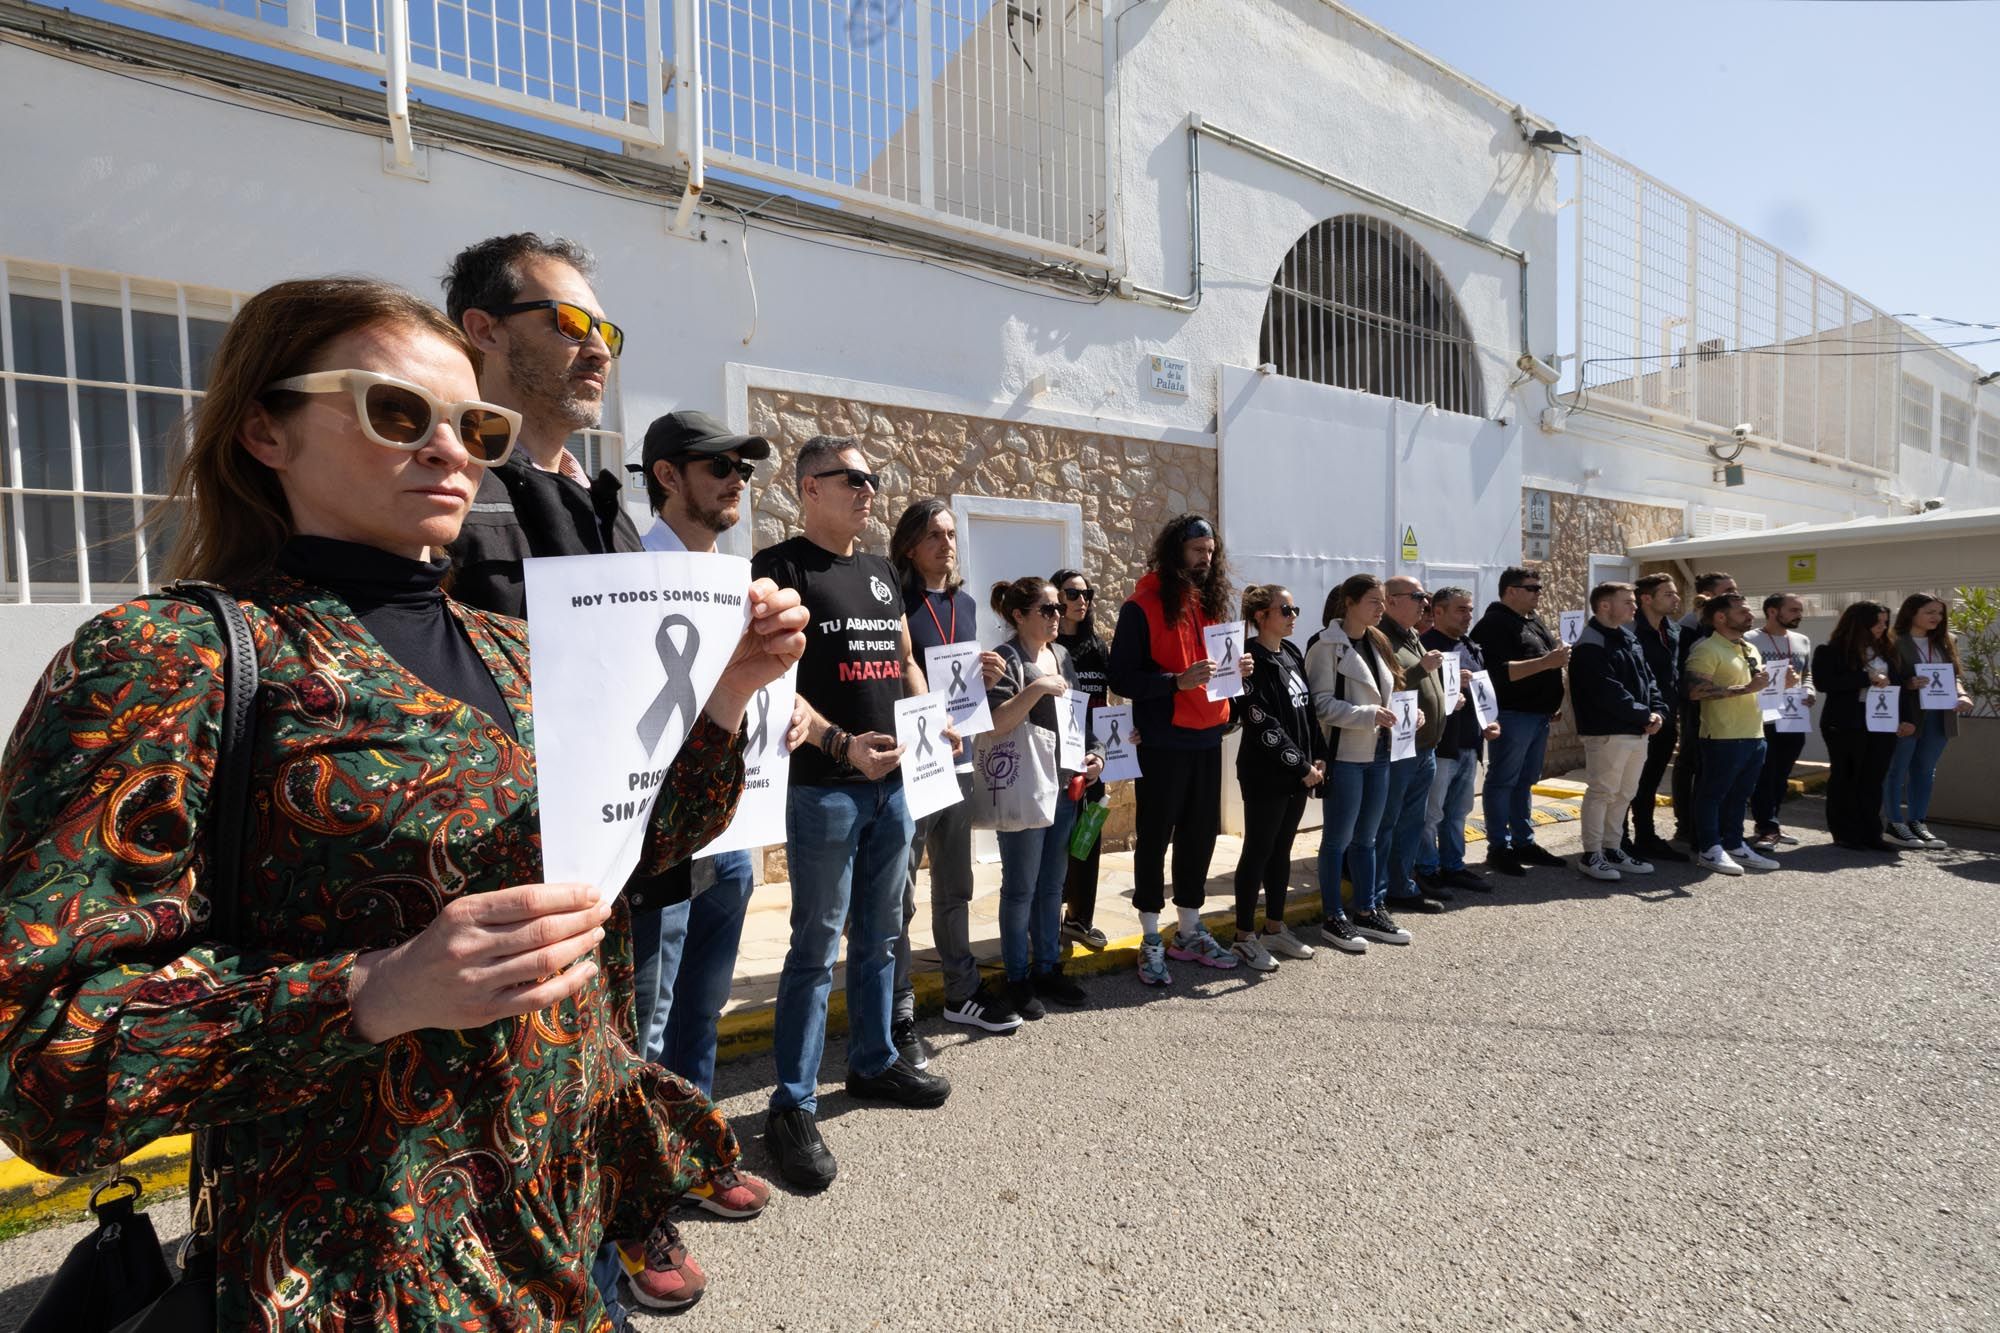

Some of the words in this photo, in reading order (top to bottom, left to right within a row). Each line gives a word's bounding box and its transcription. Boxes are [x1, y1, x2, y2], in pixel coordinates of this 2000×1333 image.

[571, 594, 603, 607] HOY
[608, 590, 658, 604] TODOS
[663, 590, 710, 602] SOMOS
[713, 592, 741, 606] NURIA
[820, 619, 841, 634] TU
[846, 617, 902, 632] ABANDON
[849, 640, 865, 651] ME
[866, 640, 896, 651] PUEDE
[838, 660, 901, 682] MATAR
[602, 801, 635, 823] SIN
